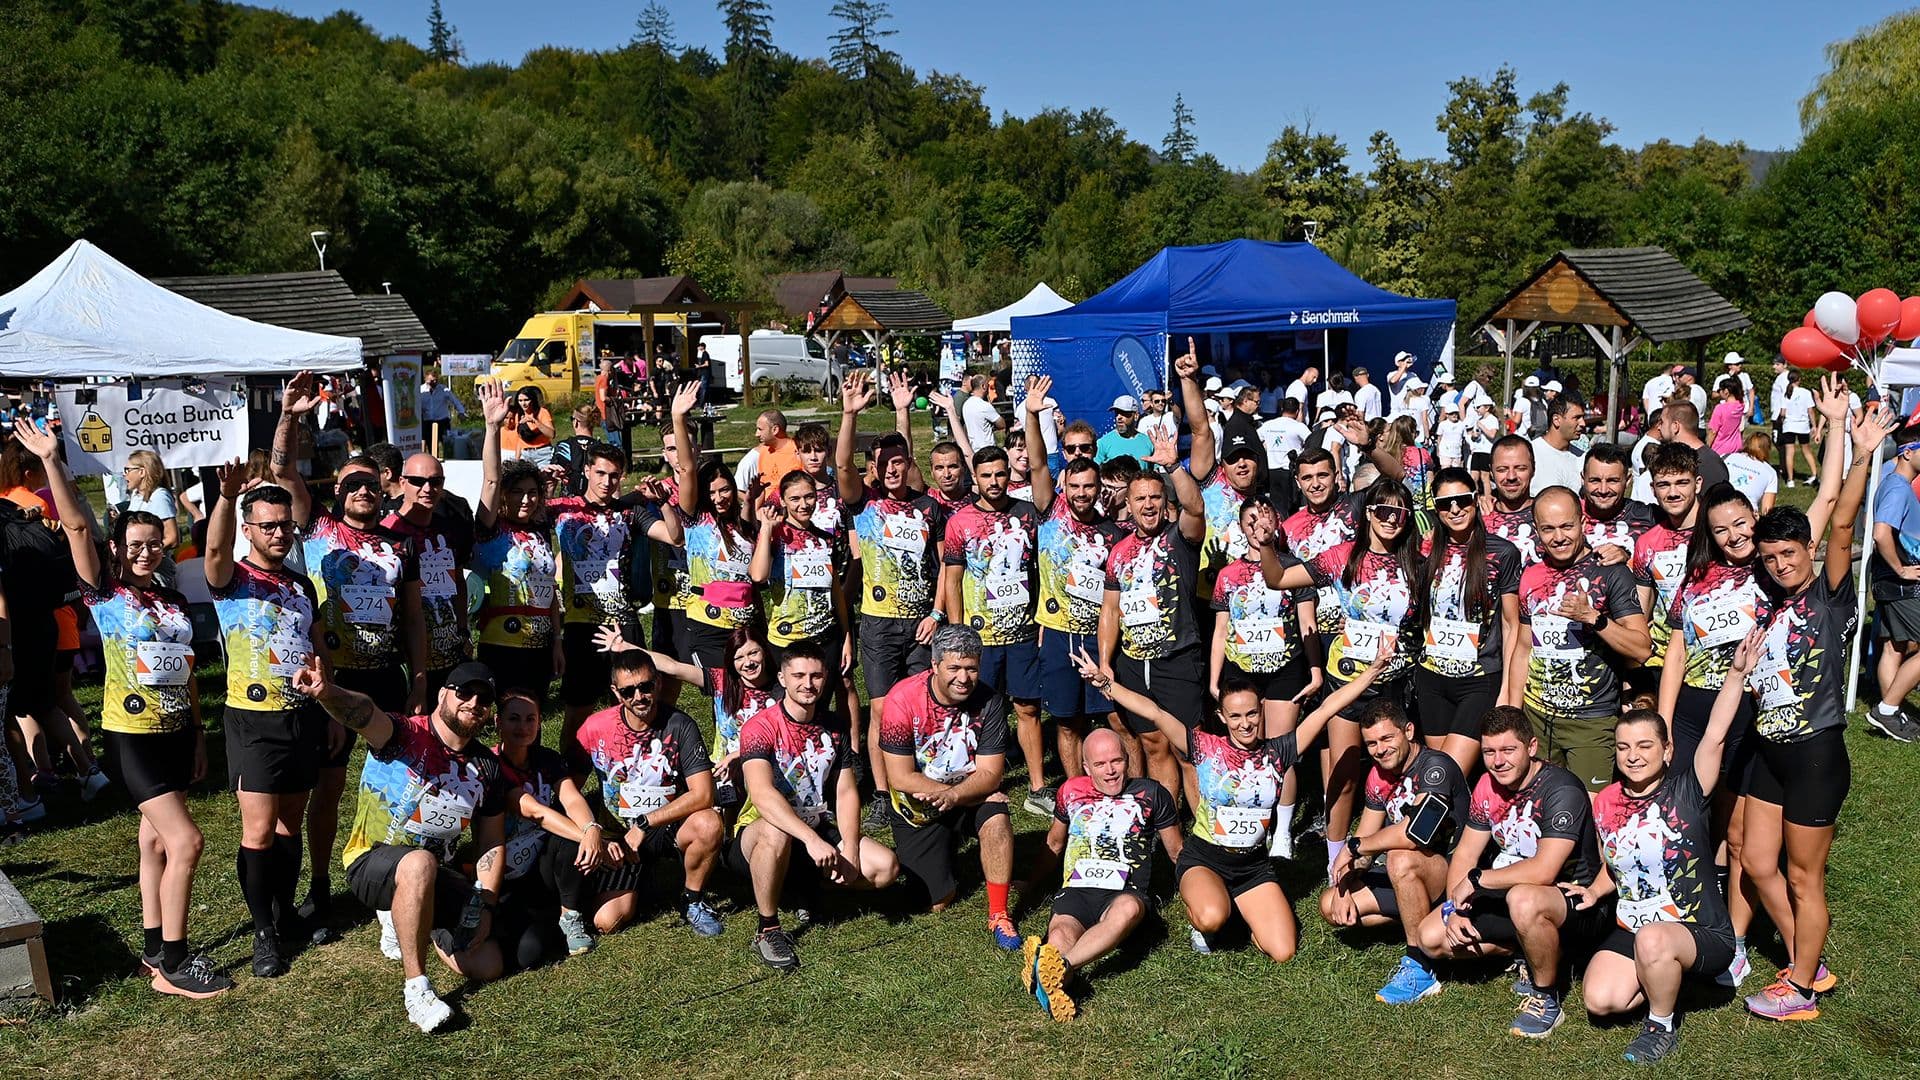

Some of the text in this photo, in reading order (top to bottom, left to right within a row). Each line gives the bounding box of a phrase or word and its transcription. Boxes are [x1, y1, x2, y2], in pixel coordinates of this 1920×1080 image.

[1301, 307, 1360, 325] Benchmark
[124, 403, 234, 426] Casa Bună
[125, 428, 222, 450] Sânpetru
[894, 526, 919, 541] 266
[728, 551, 751, 565] 246
[584, 571, 608, 583] 694
[802, 565, 825, 577] 248
[1665, 562, 1684, 578] 27
[425, 571, 446, 585] 241
[1078, 575, 1101, 591] 261
[533, 585, 552, 598] 272
[996, 583, 1020, 598] 693
[354, 597, 384, 611] 274
[1123, 600, 1147, 615] 243
[1705, 610, 1740, 632] 258
[1246, 630, 1272, 643] 247
[1353, 632, 1380, 648] 271
[1437, 630, 1465, 647] 257
[152, 656, 183, 672] 260
[1758, 675, 1779, 694] 250
[632, 795, 662, 808] 244
[424, 810, 457, 830] 253
[1228, 820, 1258, 834] 255
[513, 841, 539, 866] 691
[1085, 868, 1114, 879] 687
